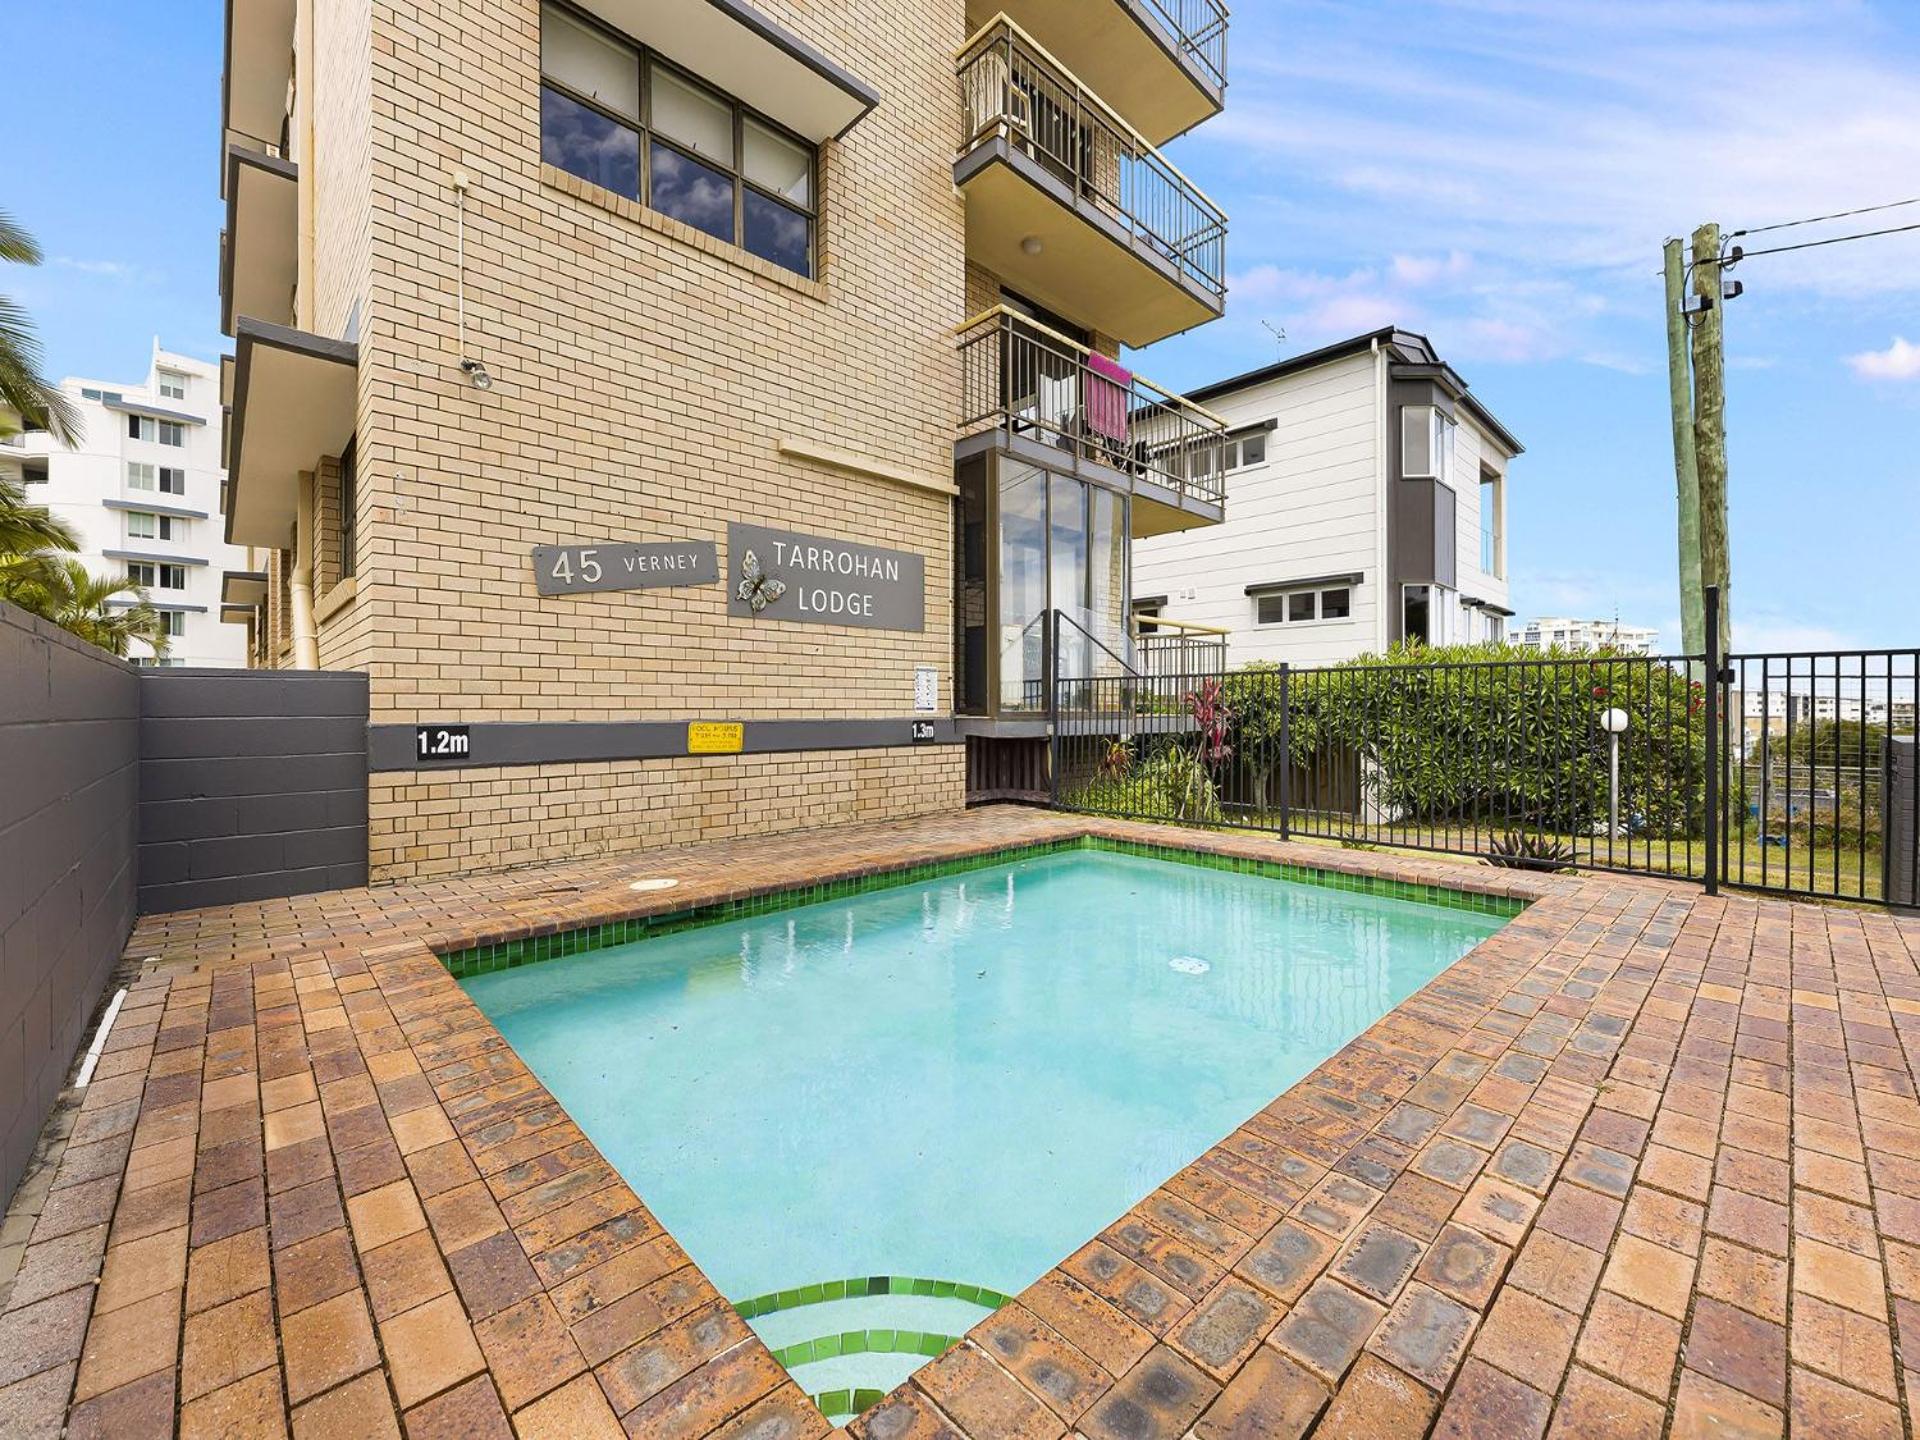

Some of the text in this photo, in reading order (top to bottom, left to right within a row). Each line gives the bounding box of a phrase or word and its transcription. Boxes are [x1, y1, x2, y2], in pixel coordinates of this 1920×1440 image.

[552, 550, 698, 585] 45 VERNEY
[773, 541, 898, 581] TARROHAN
[799, 587, 873, 616] LODGE
[418, 730, 468, 754] 1.2m
[912, 722, 934, 738] 1.3m
